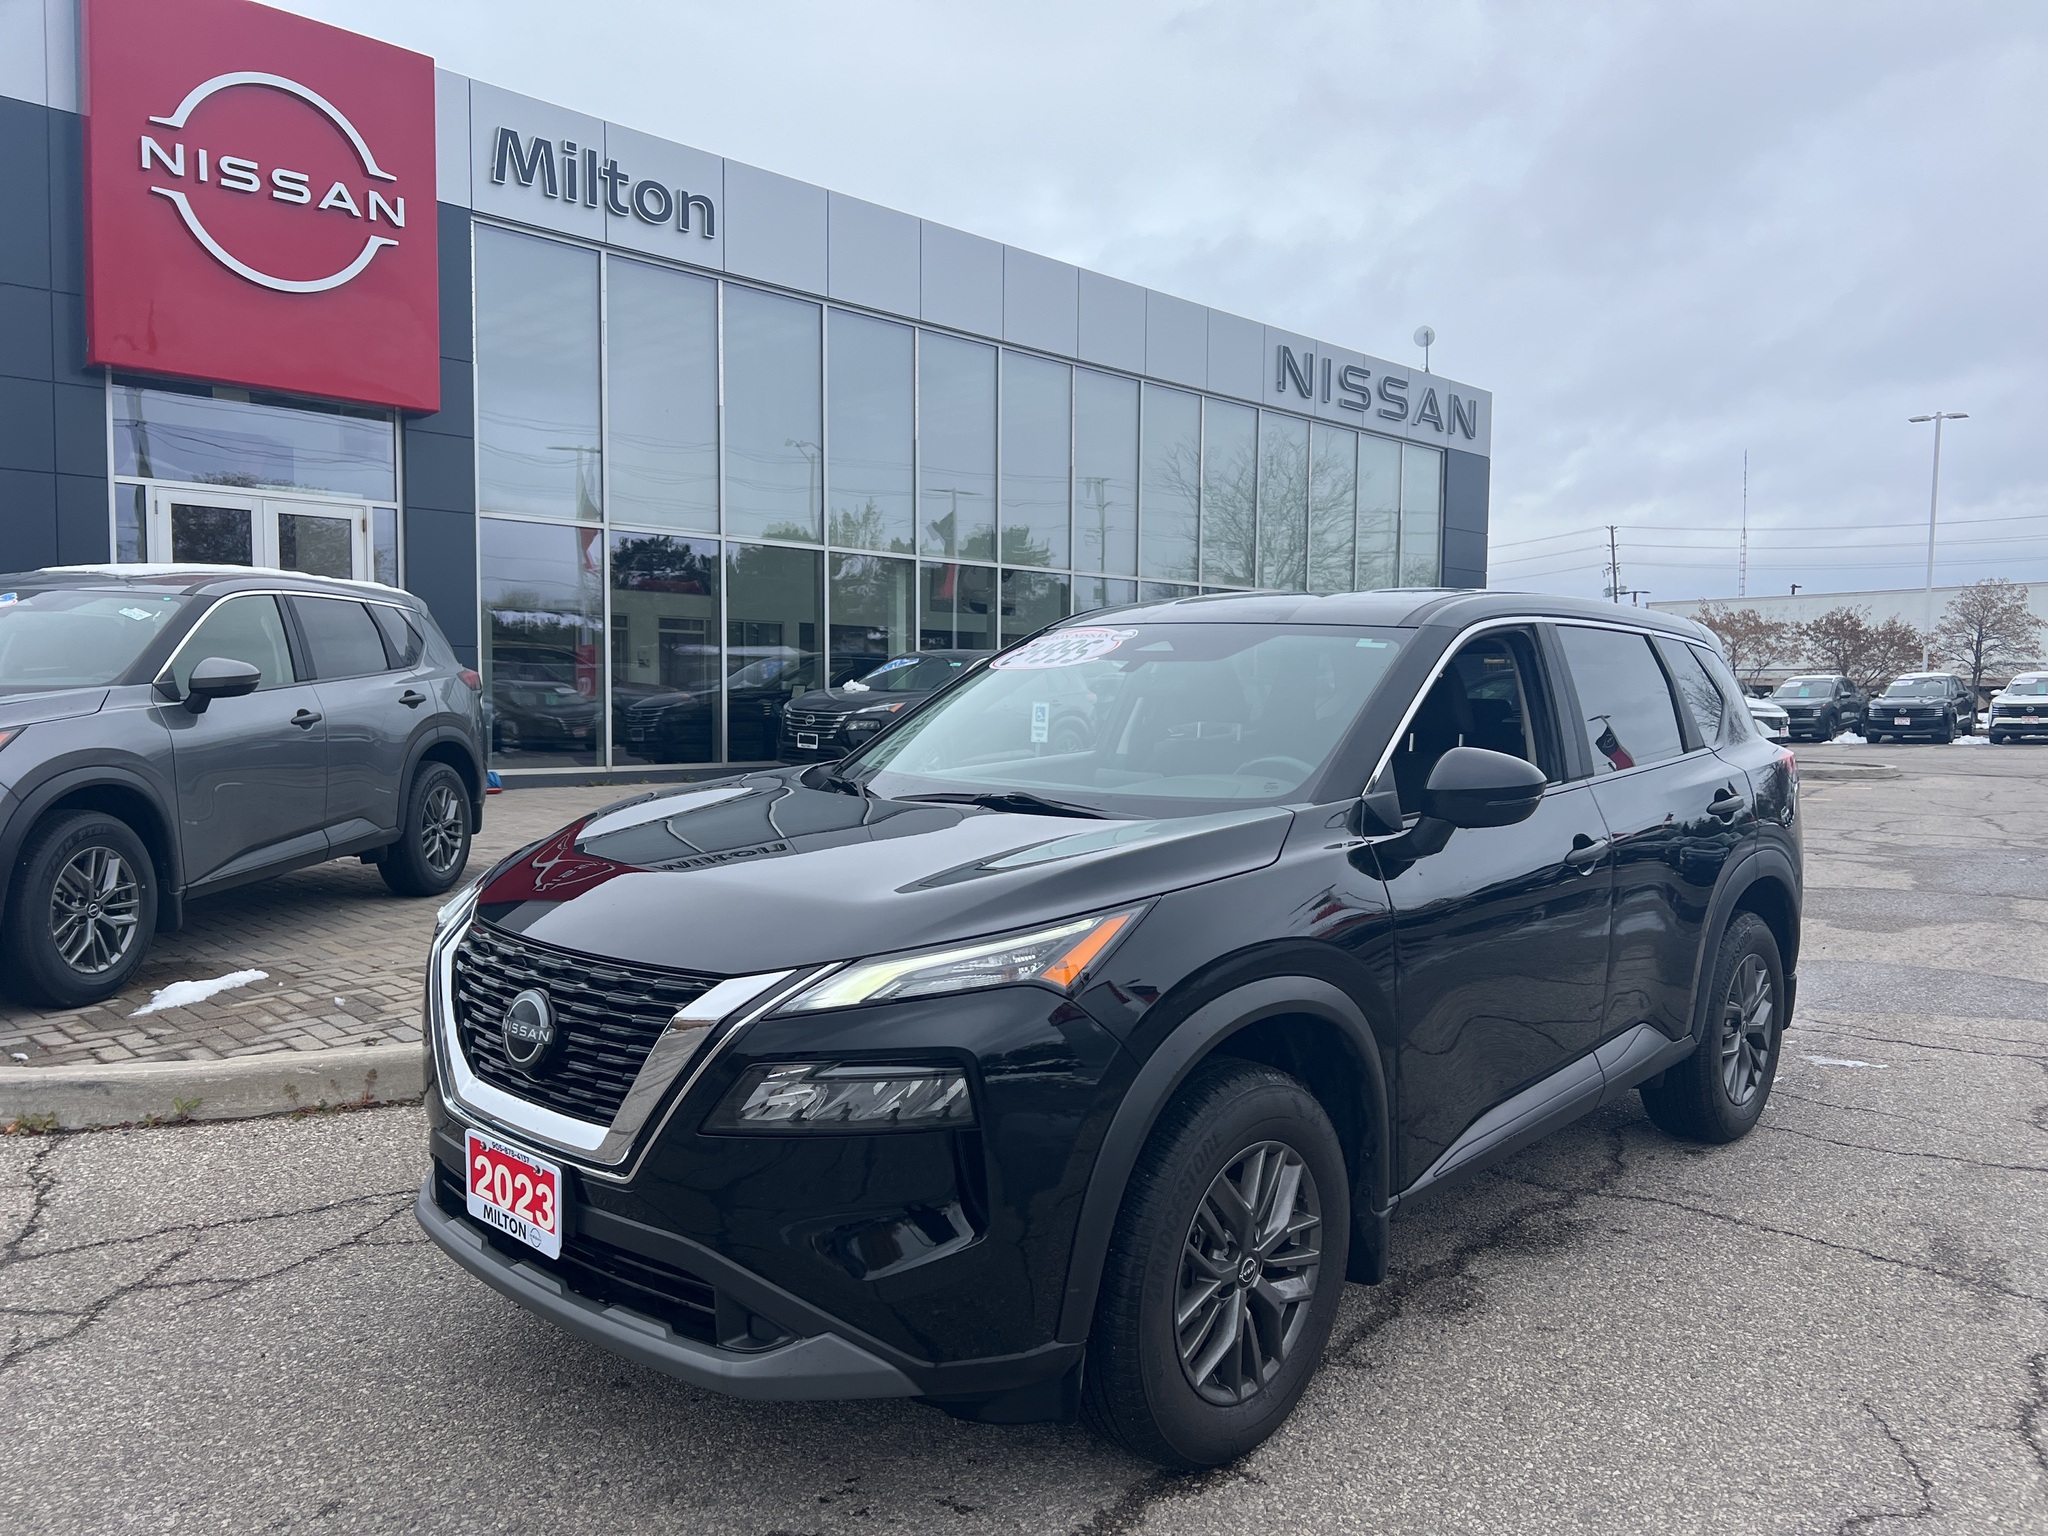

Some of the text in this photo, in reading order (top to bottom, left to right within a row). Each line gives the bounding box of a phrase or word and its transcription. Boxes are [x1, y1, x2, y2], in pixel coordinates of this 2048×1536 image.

[140, 135, 405, 228] NISSAN
[493, 126, 716, 240] Milton
[1277, 344, 1477, 440] NISSAN
[503, 1016, 550, 1042] NISSAN
[474, 1155, 554, 1230] 2023
[483, 1204, 527, 1240] MILTON
